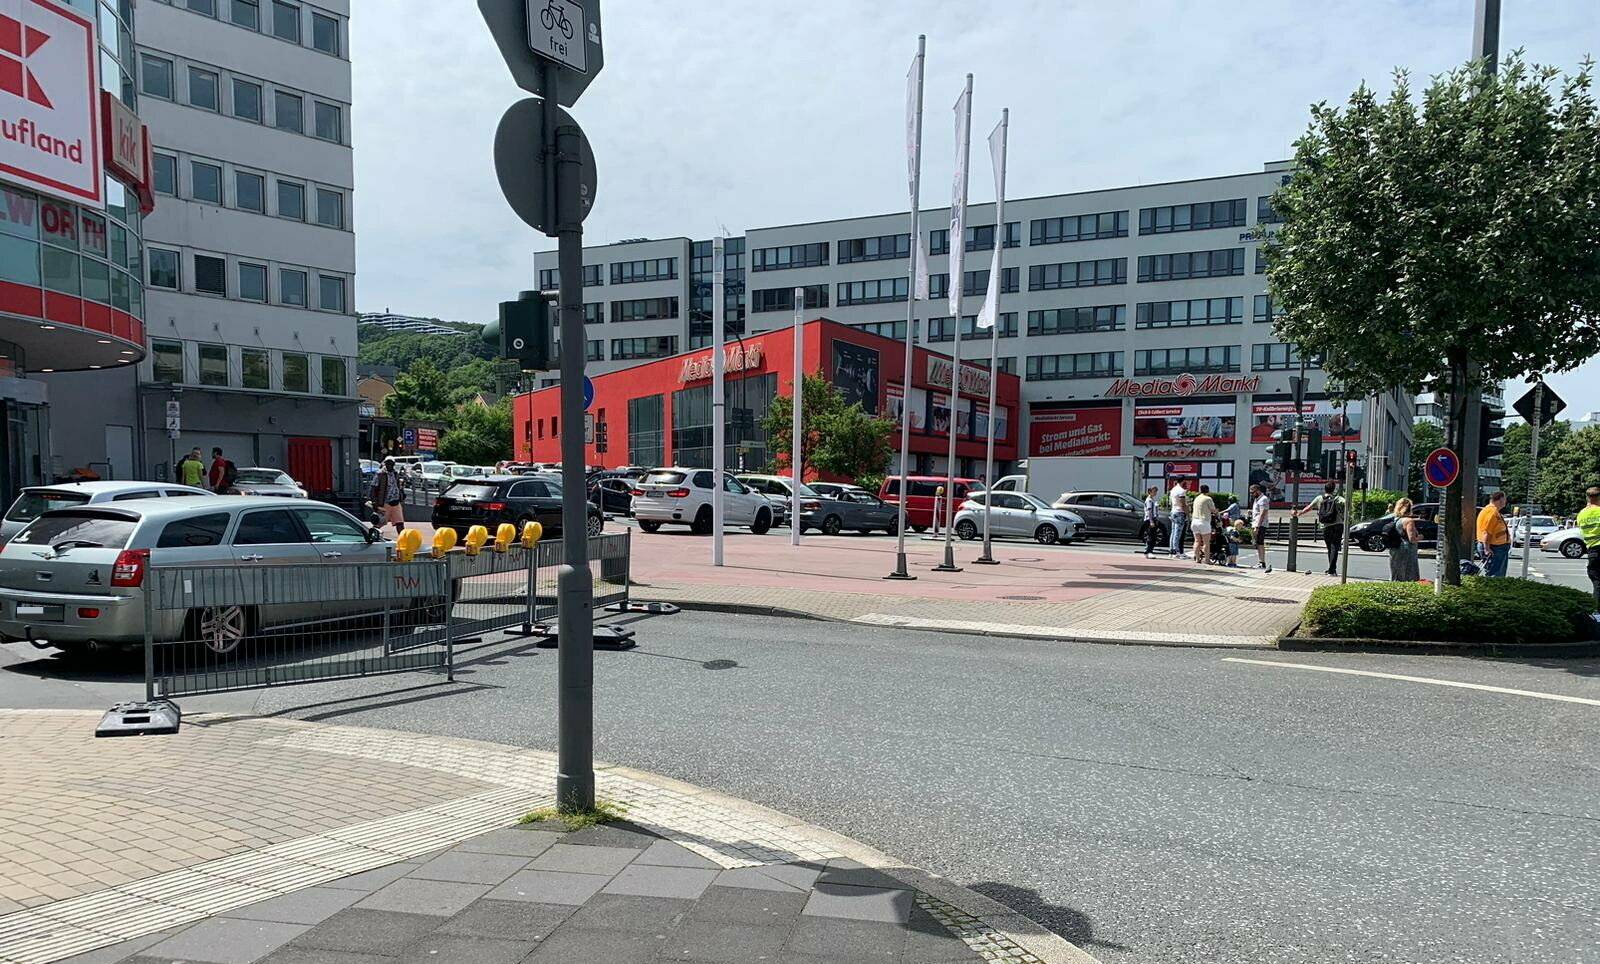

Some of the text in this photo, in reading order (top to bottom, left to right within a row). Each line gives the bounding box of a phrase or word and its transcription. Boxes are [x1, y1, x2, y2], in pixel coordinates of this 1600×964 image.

[550, 36, 568, 57] frei
[1, 118, 82, 164] ufland
[119, 117, 137, 168] kik
[1103, 374, 1262, 397] Media Markt
[1039, 431, 1111, 453] bei MediaMarkt:
[1041, 423, 1103, 443] Strom und Gas
[1144, 448, 1217, 458] Media Markt
